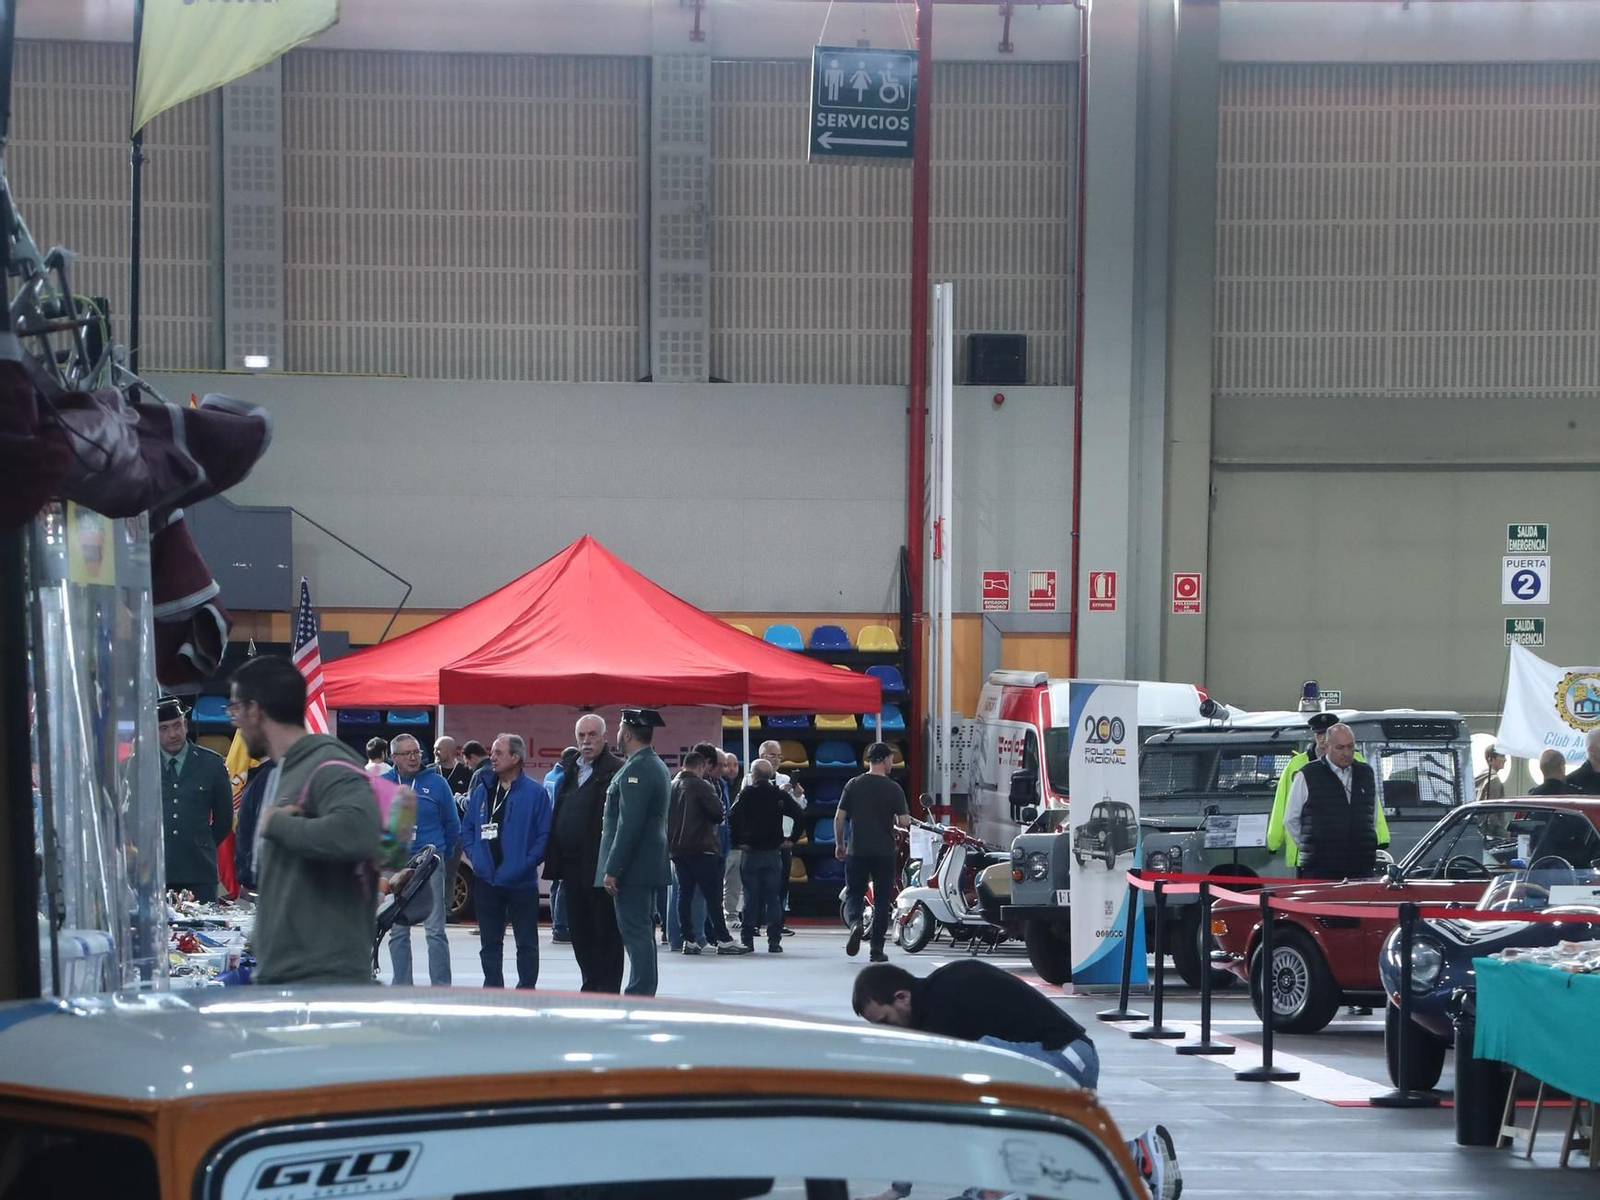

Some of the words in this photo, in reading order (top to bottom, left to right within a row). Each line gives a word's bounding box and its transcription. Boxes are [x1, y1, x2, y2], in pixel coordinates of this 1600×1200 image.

[817, 113, 910, 130] SERVICIOS
[1517, 525, 1538, 538] SALIDA
[1509, 539, 1546, 551] EMERGENCIA
[1506, 560, 1546, 568] PUERTA
[1517, 574, 1535, 595] 2
[1514, 620, 1535, 632] SALIDA
[1085, 715, 1125, 744] 200
[1544, 731, 1570, 748] Club
[1085, 756, 1126, 765] NACIONAL
